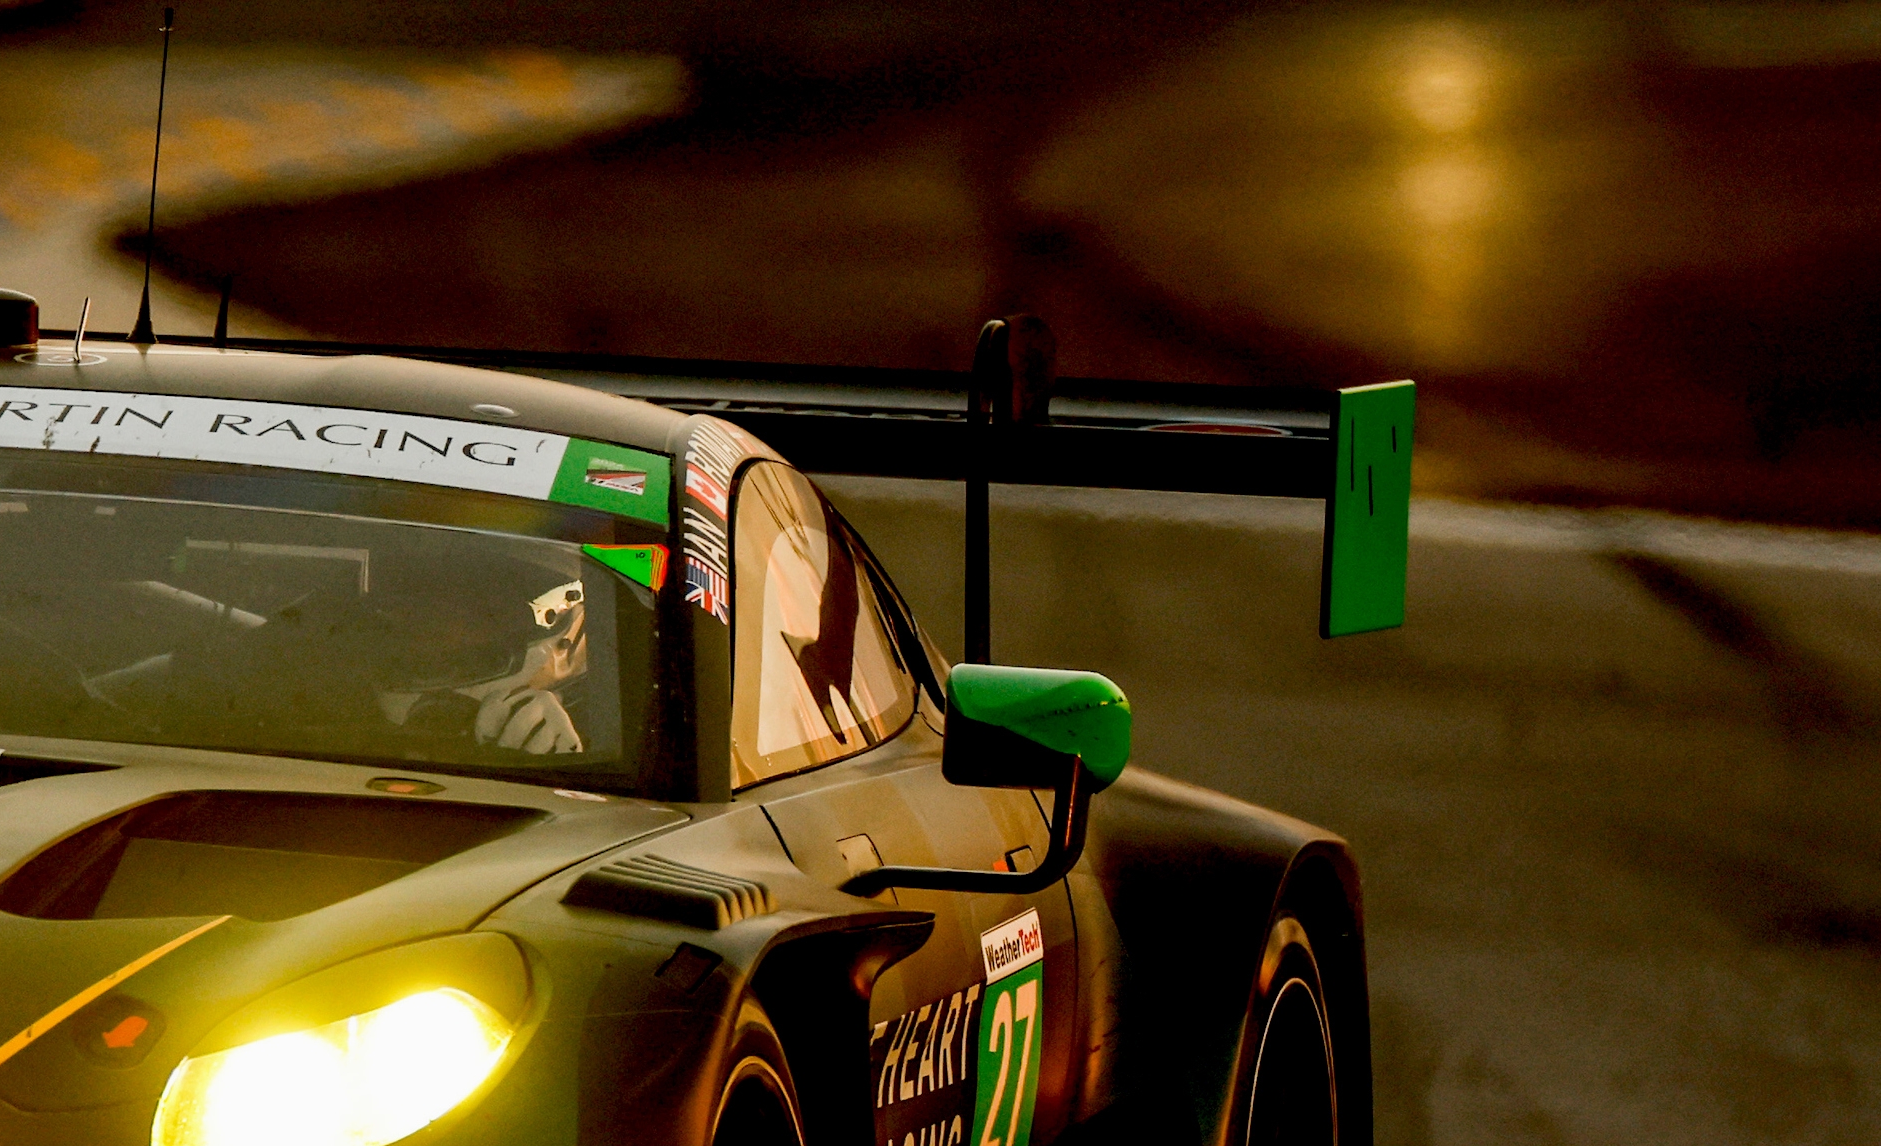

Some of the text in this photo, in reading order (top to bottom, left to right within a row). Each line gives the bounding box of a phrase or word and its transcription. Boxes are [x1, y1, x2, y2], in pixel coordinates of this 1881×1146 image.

[209, 413, 519, 467] RACING
[683, 507, 728, 580] IAN
[985, 921, 1040, 972] WeatherTech
[877, 983, 980, 1108] HEART
